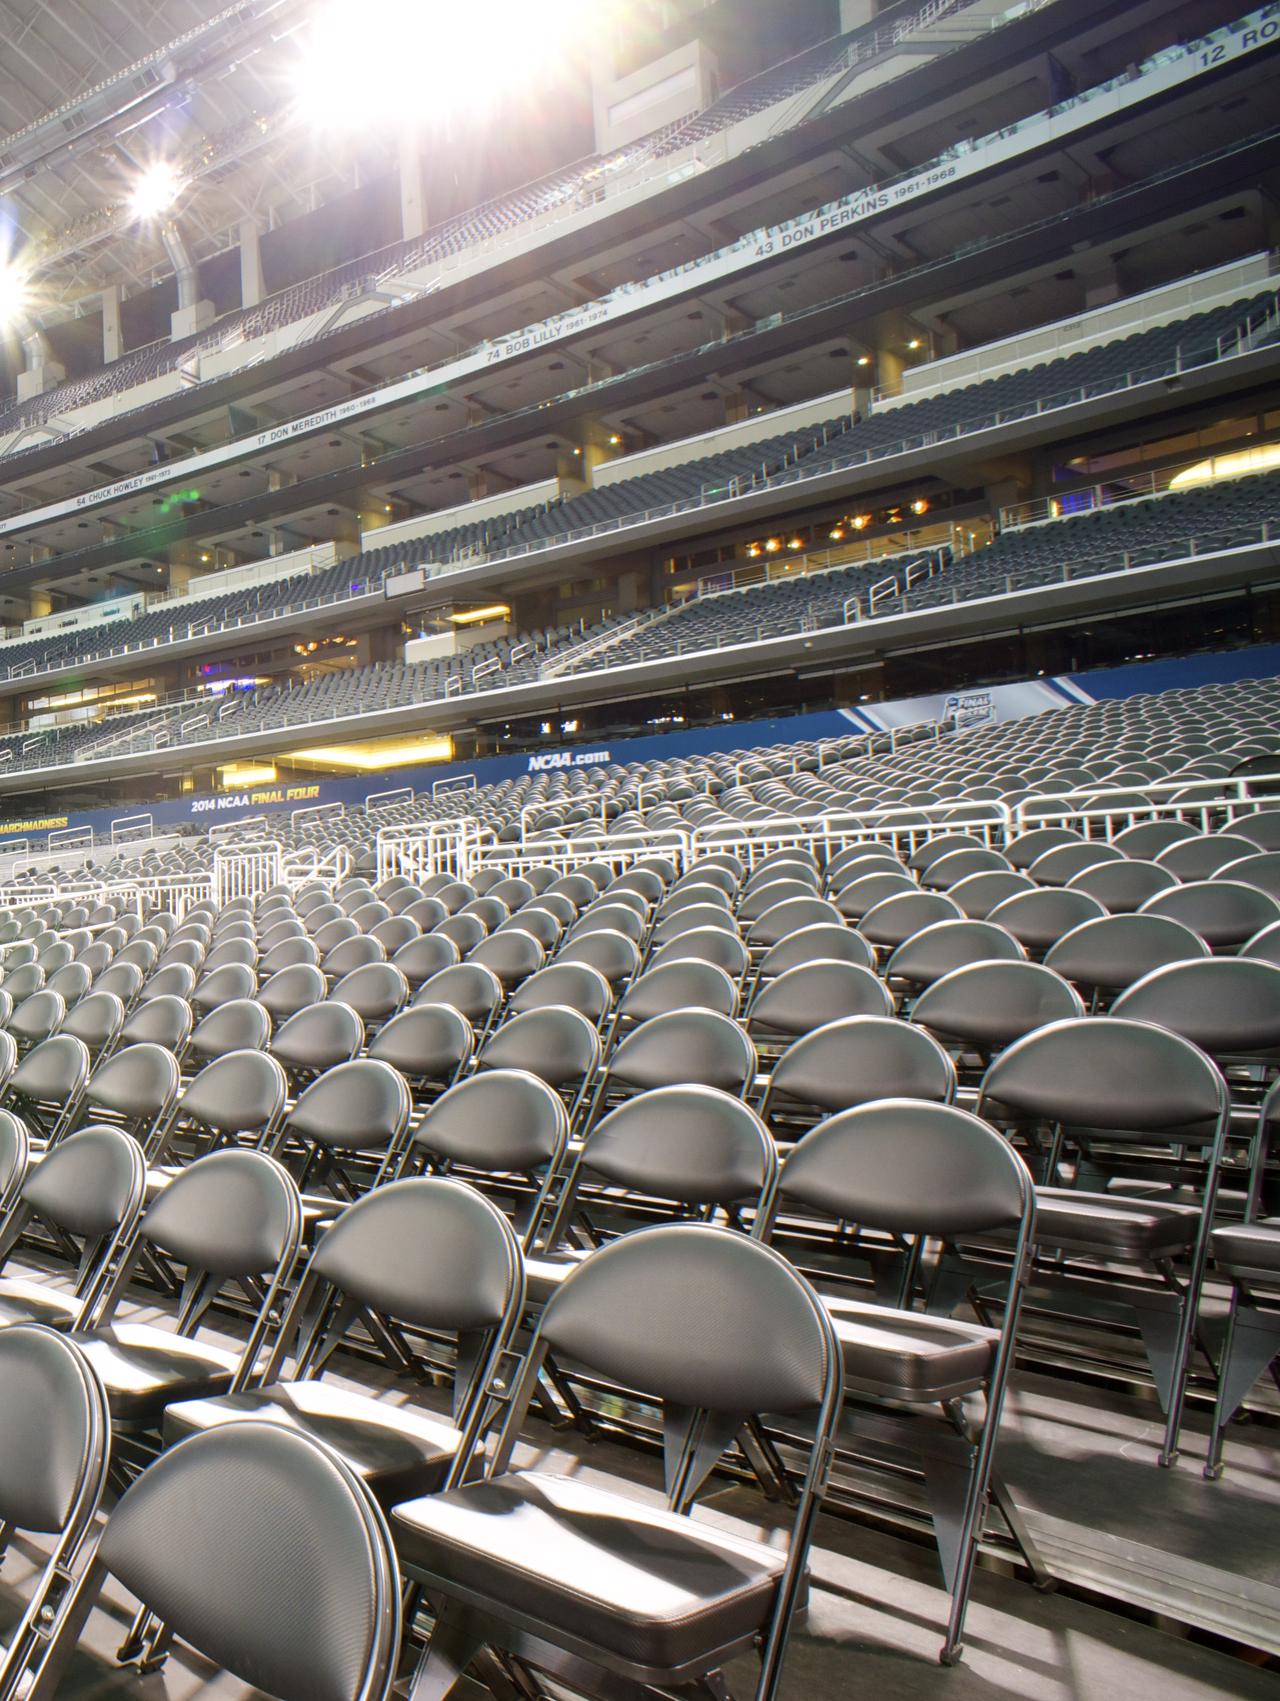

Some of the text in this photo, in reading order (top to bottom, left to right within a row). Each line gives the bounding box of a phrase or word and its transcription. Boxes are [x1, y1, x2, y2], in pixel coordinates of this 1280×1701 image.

[1201, 45, 1226, 66] 12
[755, 166, 956, 257] 43 DON PERKINS 1961-1968
[486, 349, 500, 363] 74
[505, 338, 531, 356] BOB
[533, 324, 563, 345] LILLY
[257, 434, 267, 445] 17
[270, 427, 289, 441] DON
[291, 411, 337, 433] MEREDITH
[77, 496, 86, 507] 54
[88, 489, 112, 503] CHUCK
[114, 477, 144, 494] HOWLEY
[528, 751, 611, 771] NCAA.com
[191, 786, 320, 812] 2014 NCAA FINAL FOUR
